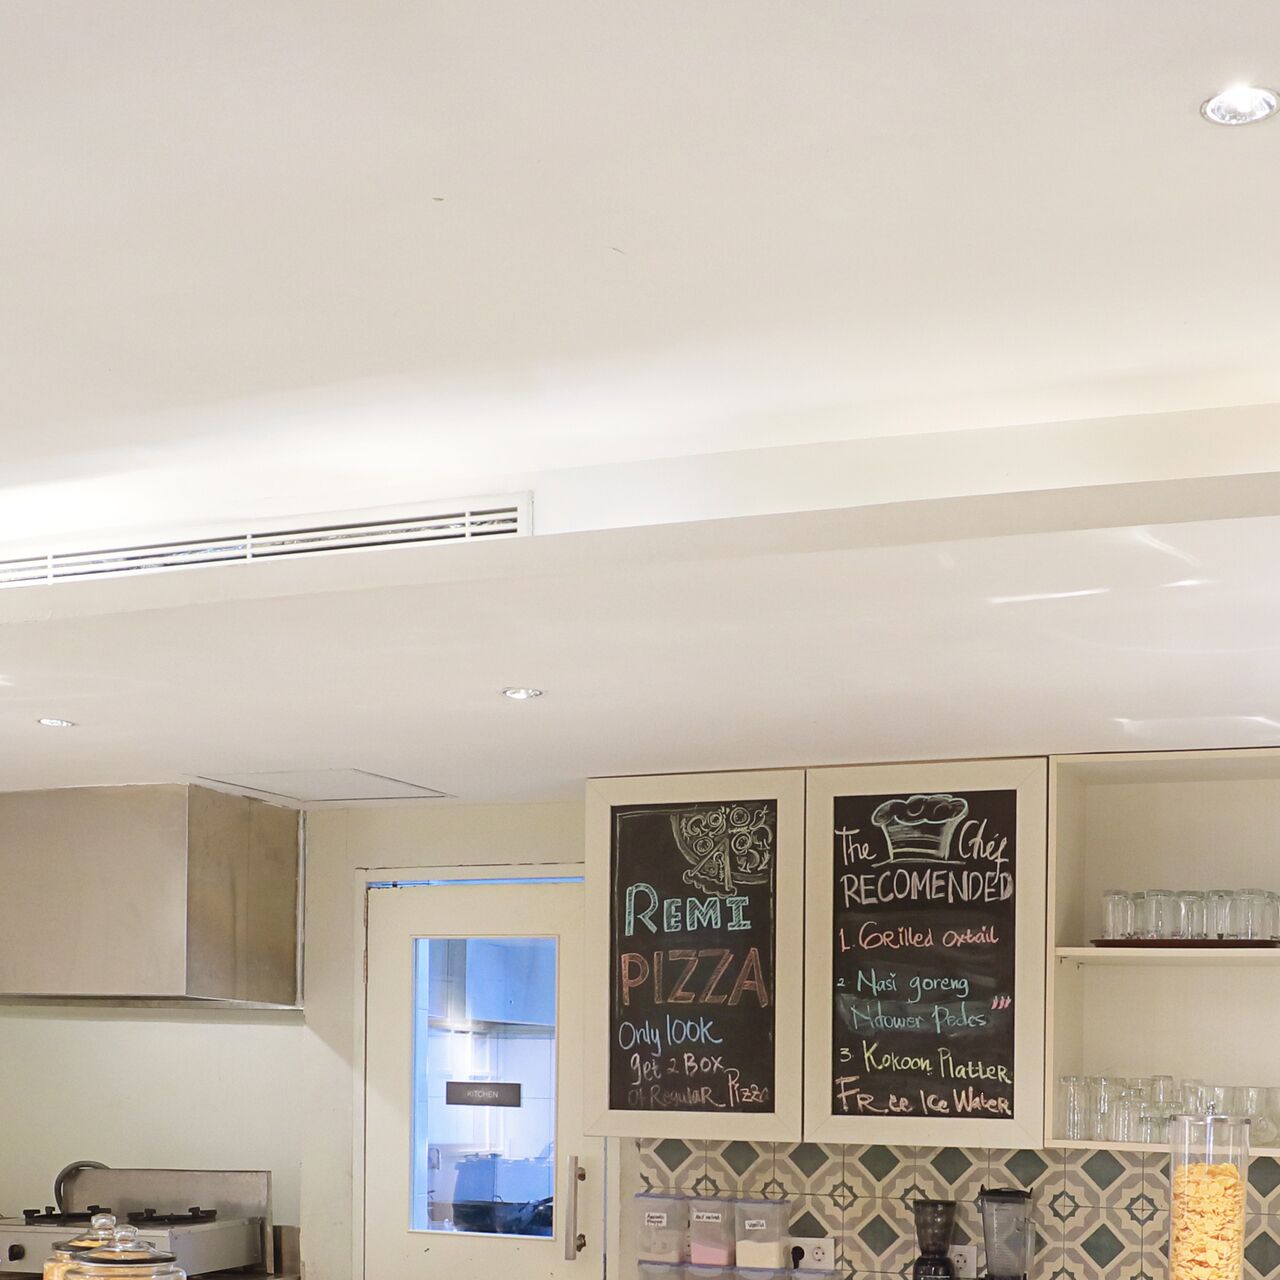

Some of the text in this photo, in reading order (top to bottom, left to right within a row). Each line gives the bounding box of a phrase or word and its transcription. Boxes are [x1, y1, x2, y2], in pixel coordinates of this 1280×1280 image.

[834, 826, 877, 866] The
[840, 868, 1014, 908] RECOMENDED
[624, 882, 752, 936] REMI
[621, 947, 769, 1008] PIZZA
[857, 968, 898, 997] Nasi
[907, 975, 970, 1004] goreng
[619, 1020, 662, 1058] Only
[467, 1090, 499, 1098] KITCHEN
